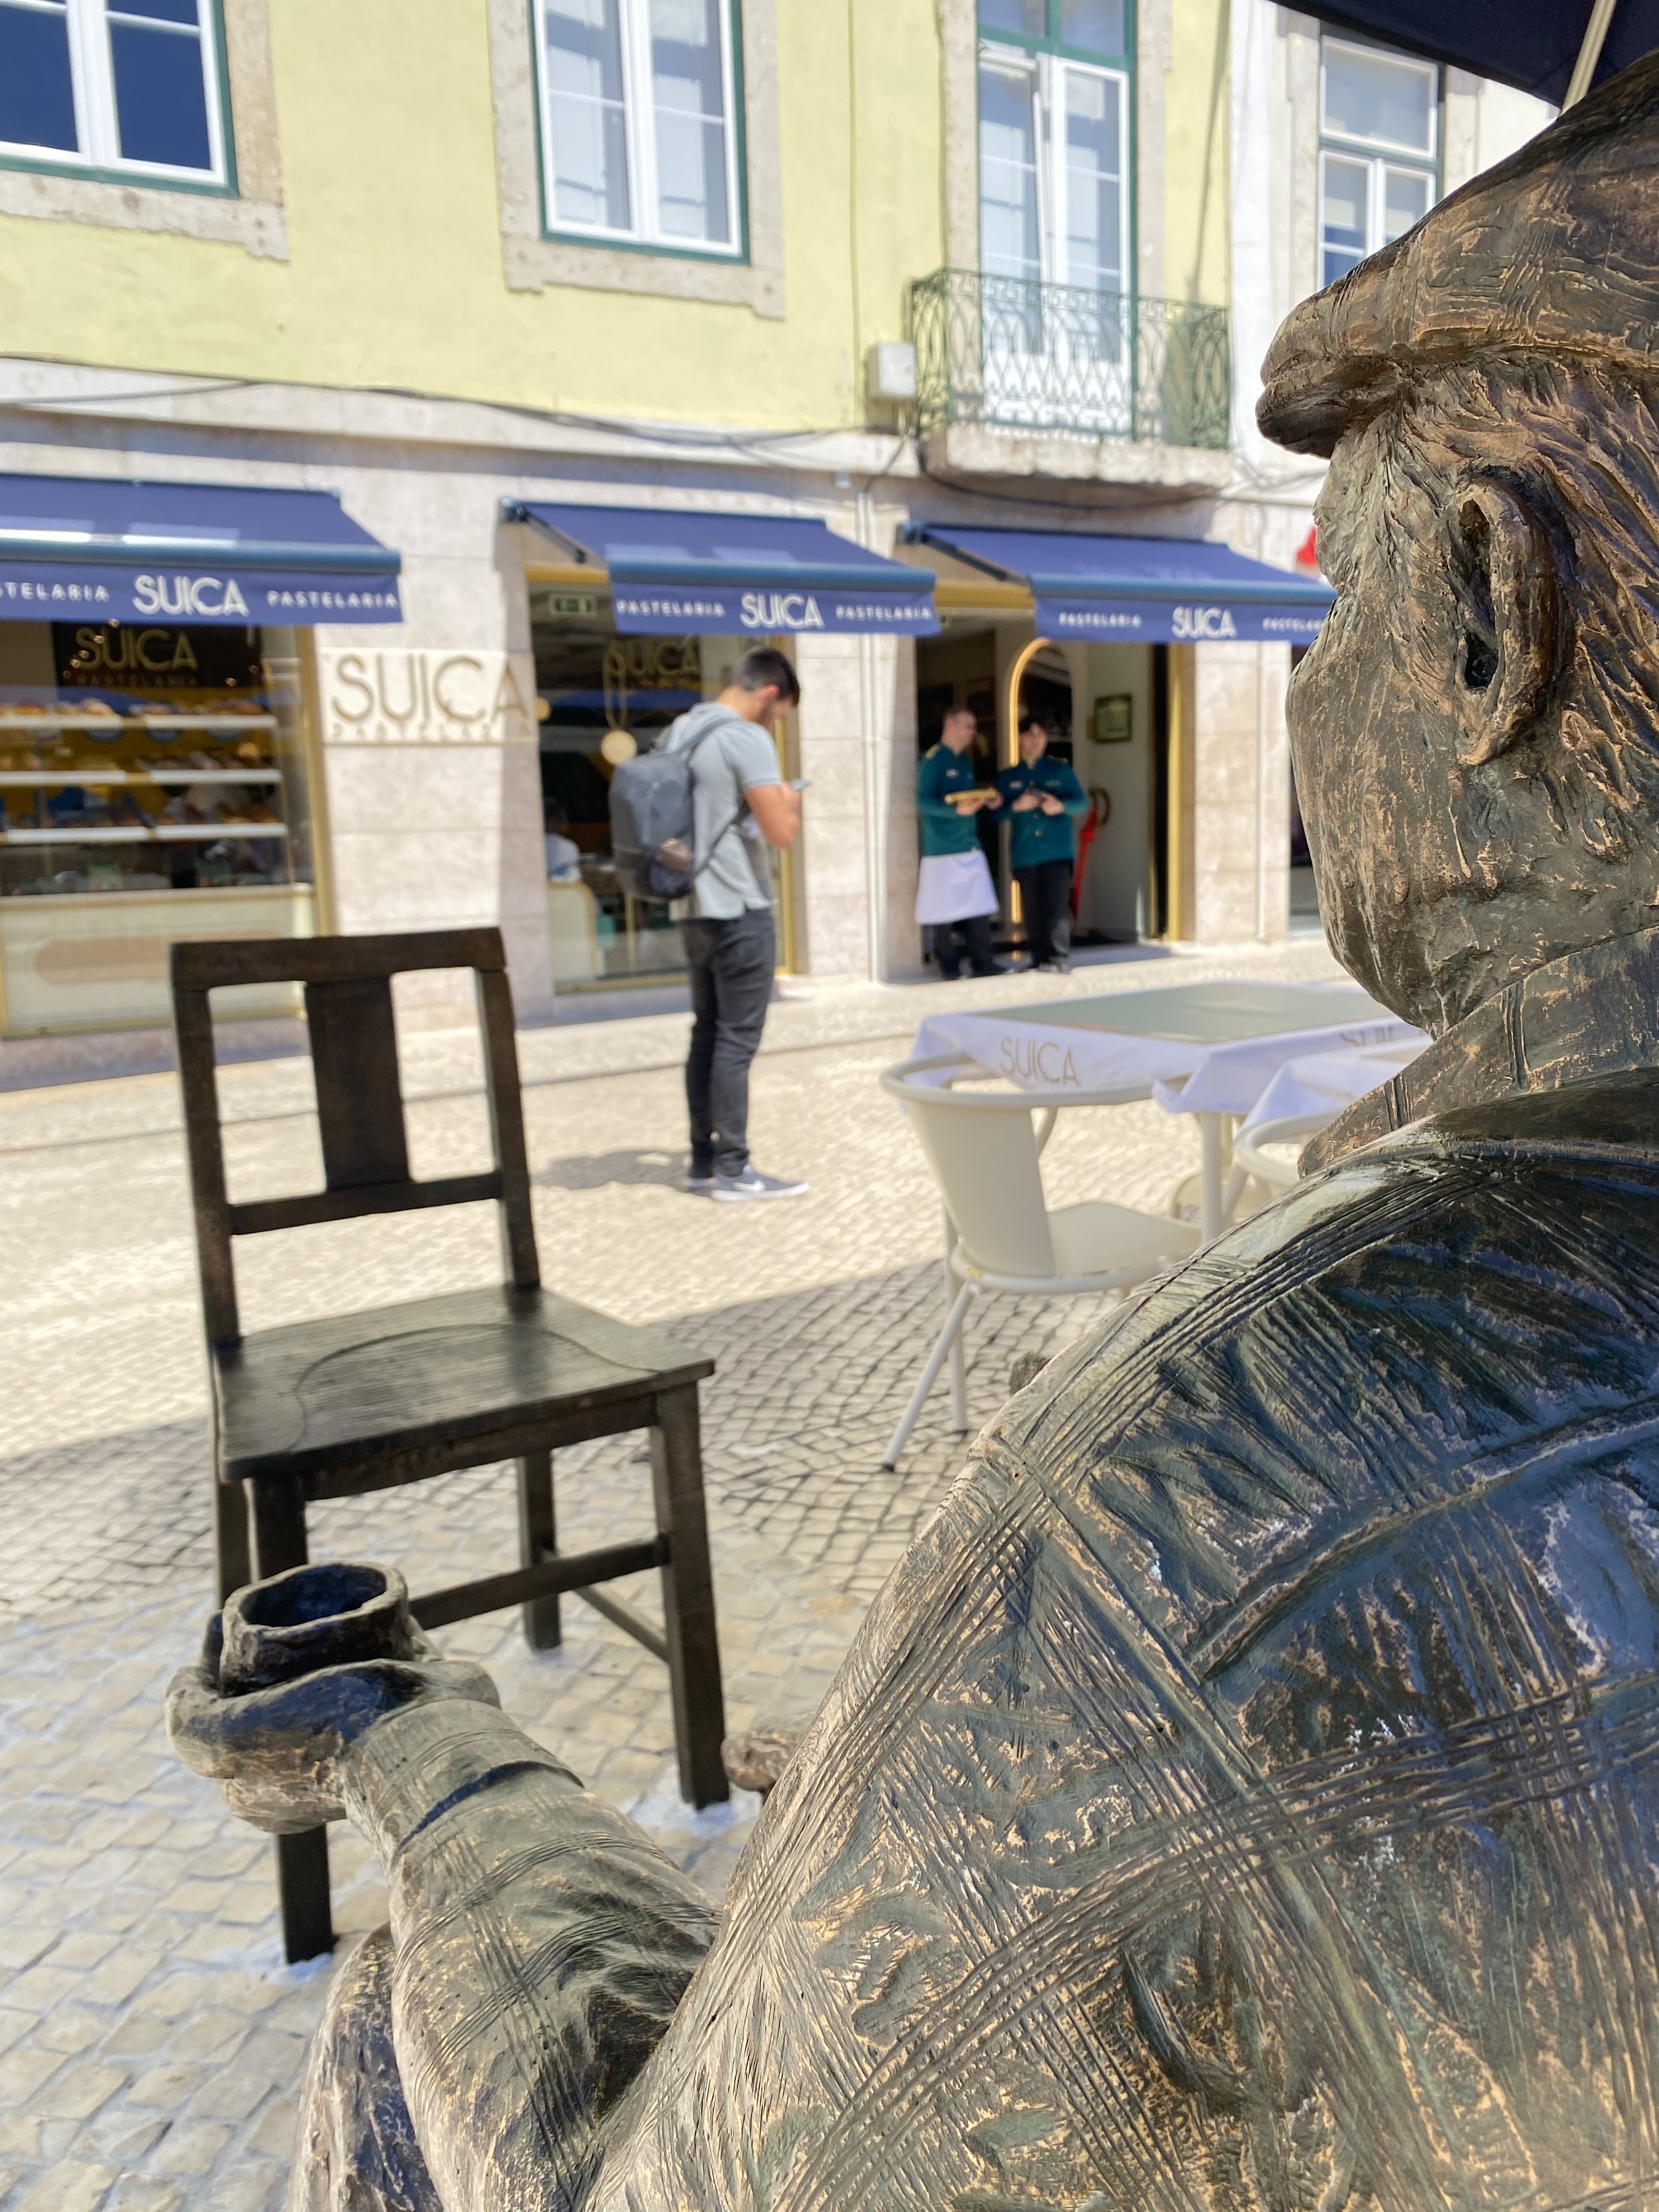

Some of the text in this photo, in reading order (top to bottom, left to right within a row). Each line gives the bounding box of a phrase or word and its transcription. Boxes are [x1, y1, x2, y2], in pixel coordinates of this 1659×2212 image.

[0, 574, 399, 617] TELARIA SUICA PASTELARIA
[616, 592, 933, 628] PASTELARIA SUICA PASTELARIA
[1058, 612, 1141, 628] PASTELARIA
[1172, 606, 1237, 638] SUICA
[331, 652, 529, 724] SUICA
[999, 1036, 1081, 1088] SUICA
